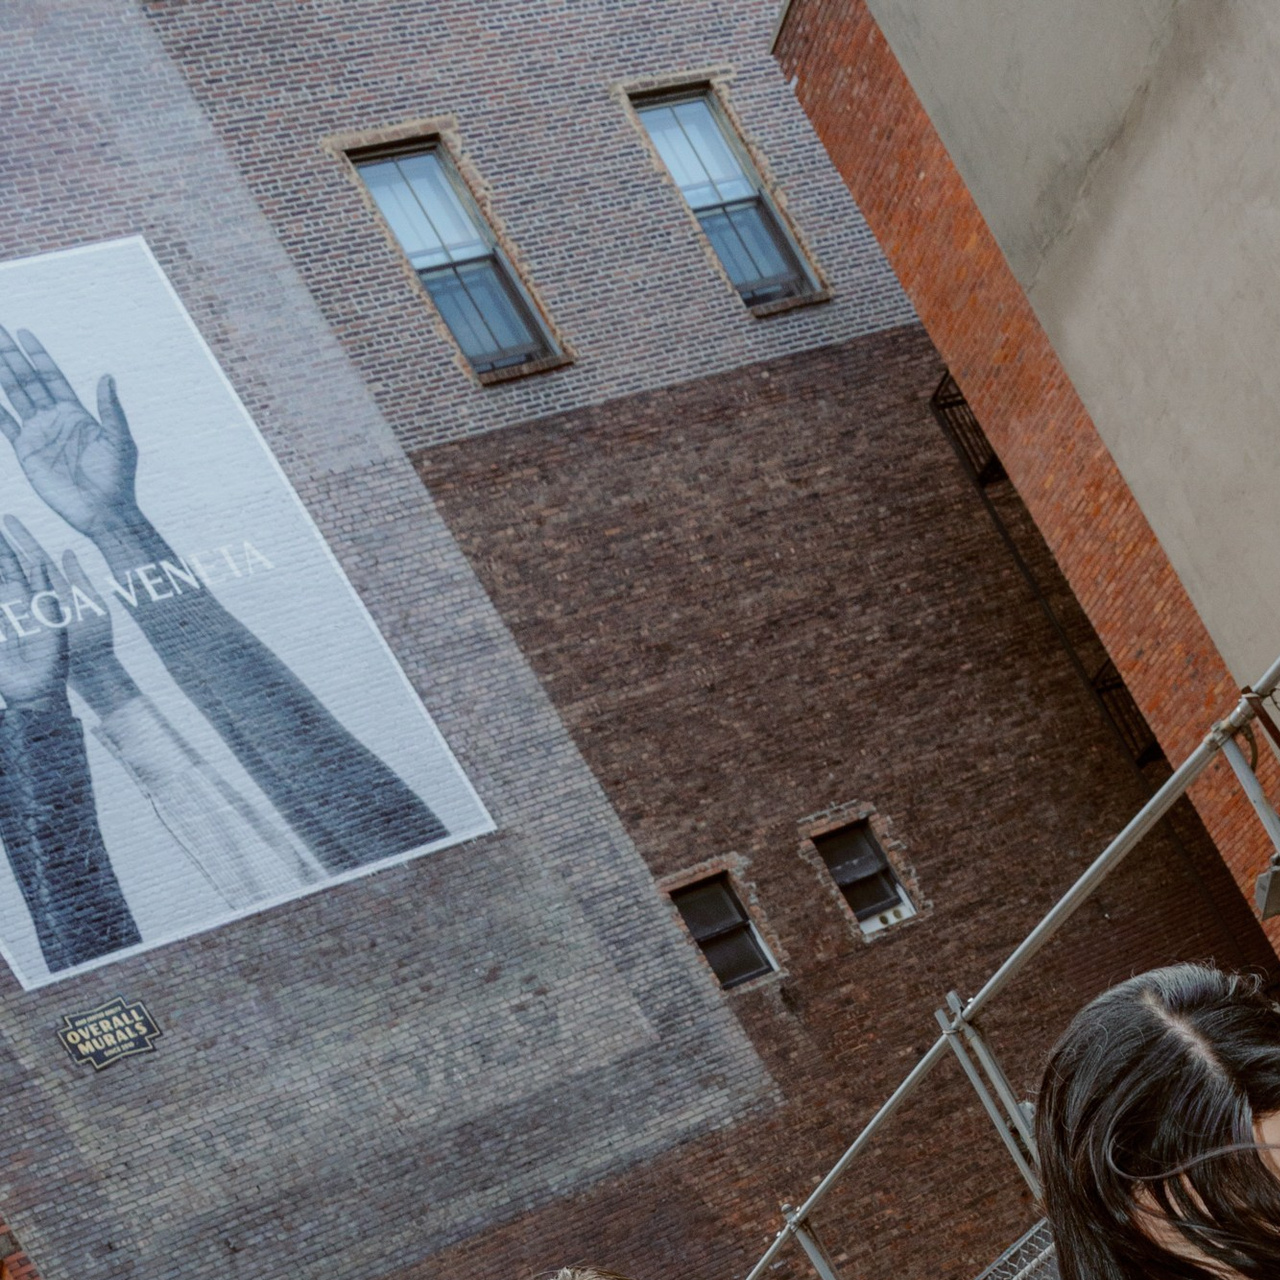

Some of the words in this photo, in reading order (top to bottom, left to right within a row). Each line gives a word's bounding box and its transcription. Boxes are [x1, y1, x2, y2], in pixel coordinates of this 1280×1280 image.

[0, 584, 107, 642] EGA
[106, 540, 275, 608] VENETA
[66, 1009, 143, 1044] OVERALL
[77, 1022, 147, 1056] MURALS
